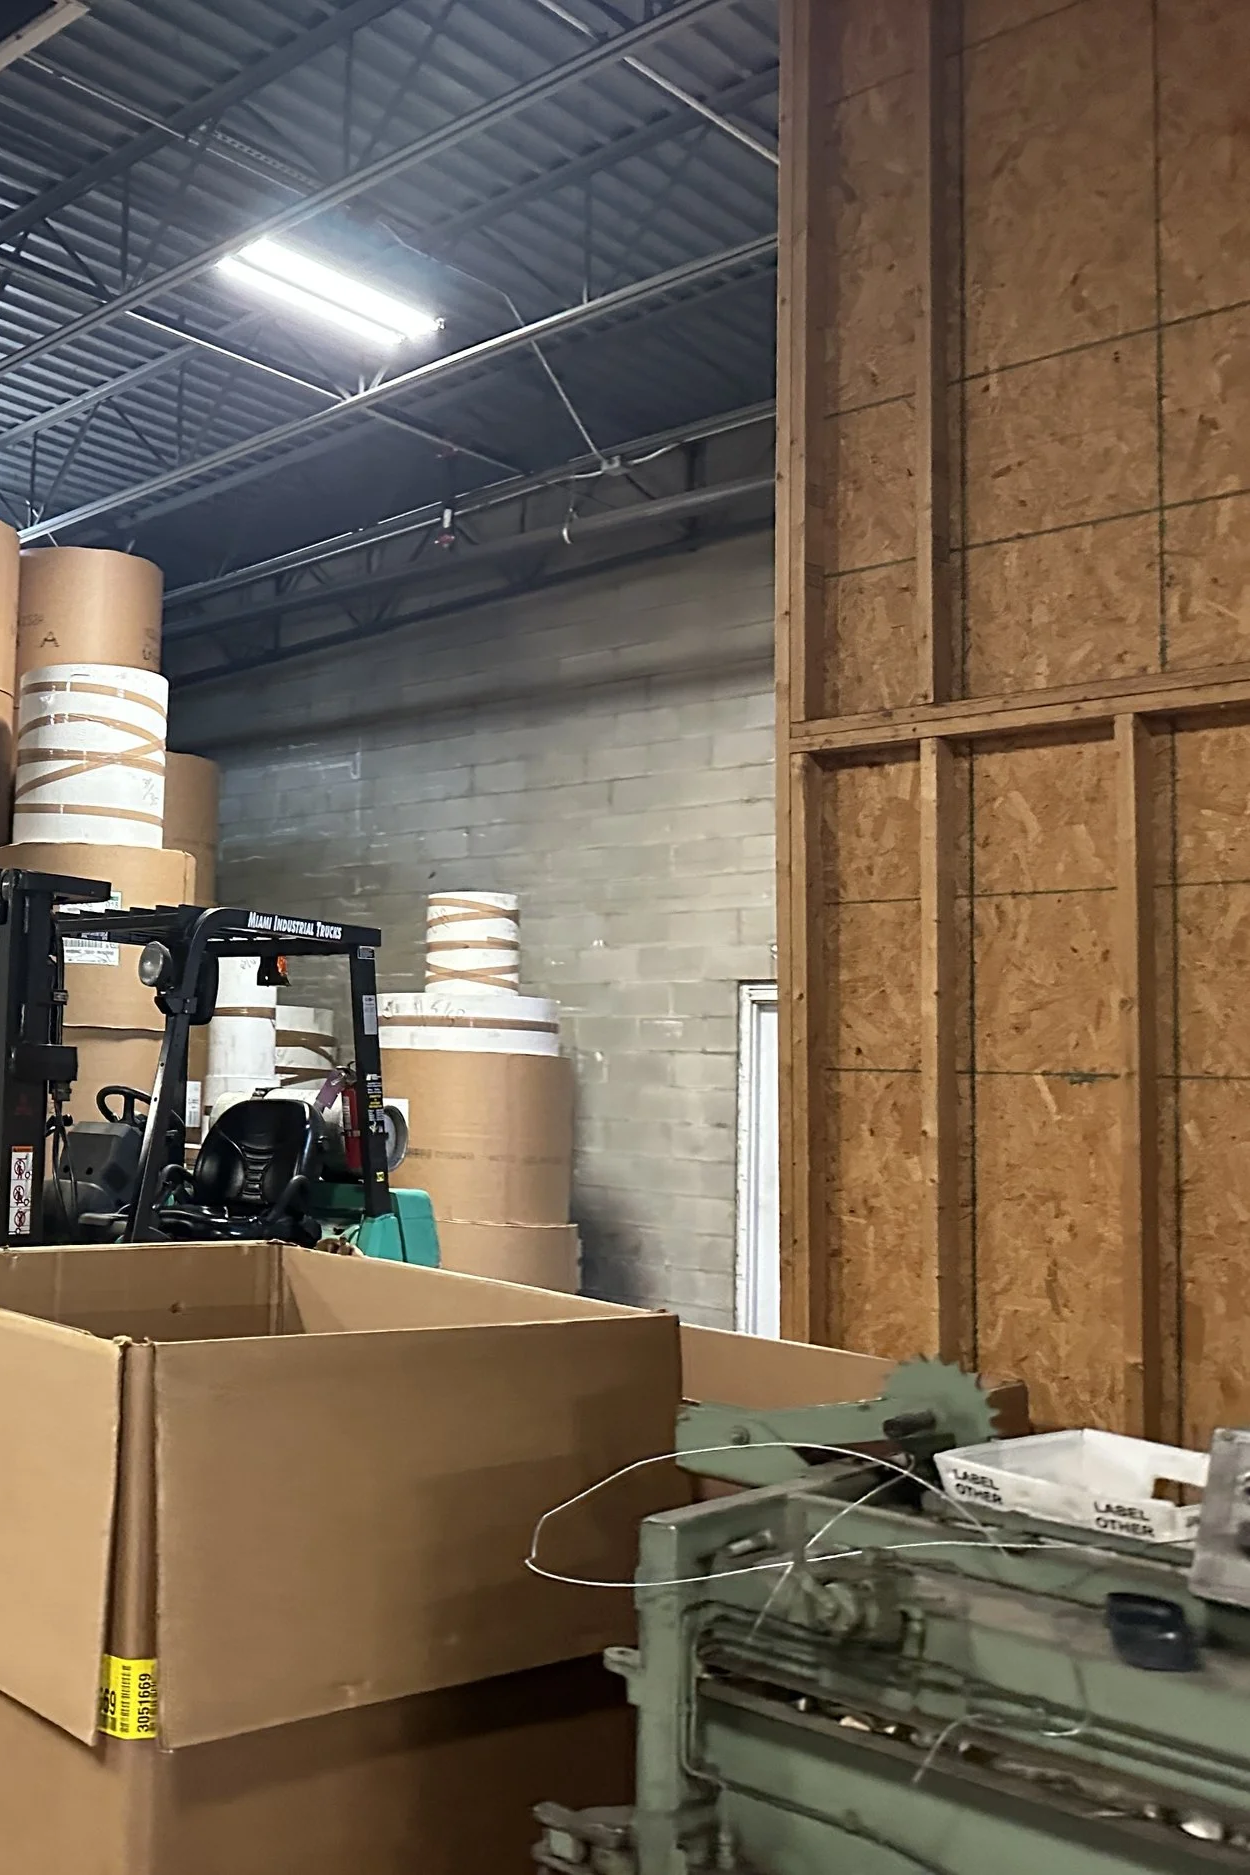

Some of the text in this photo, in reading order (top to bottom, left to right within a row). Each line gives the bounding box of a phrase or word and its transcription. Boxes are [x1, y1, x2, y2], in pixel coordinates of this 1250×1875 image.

[40, 631, 61, 648] A
[248, 911, 342, 940] MIAMI INDUSTRIAL TRUCKS
[953, 1468, 1000, 1490] LABEL
[955, 1482, 1002, 1505] OTHER
[1094, 1501, 1150, 1521] LABEL
[1095, 1517, 1155, 1538] OTHER
[137, 1673, 151, 1733] 3051669
